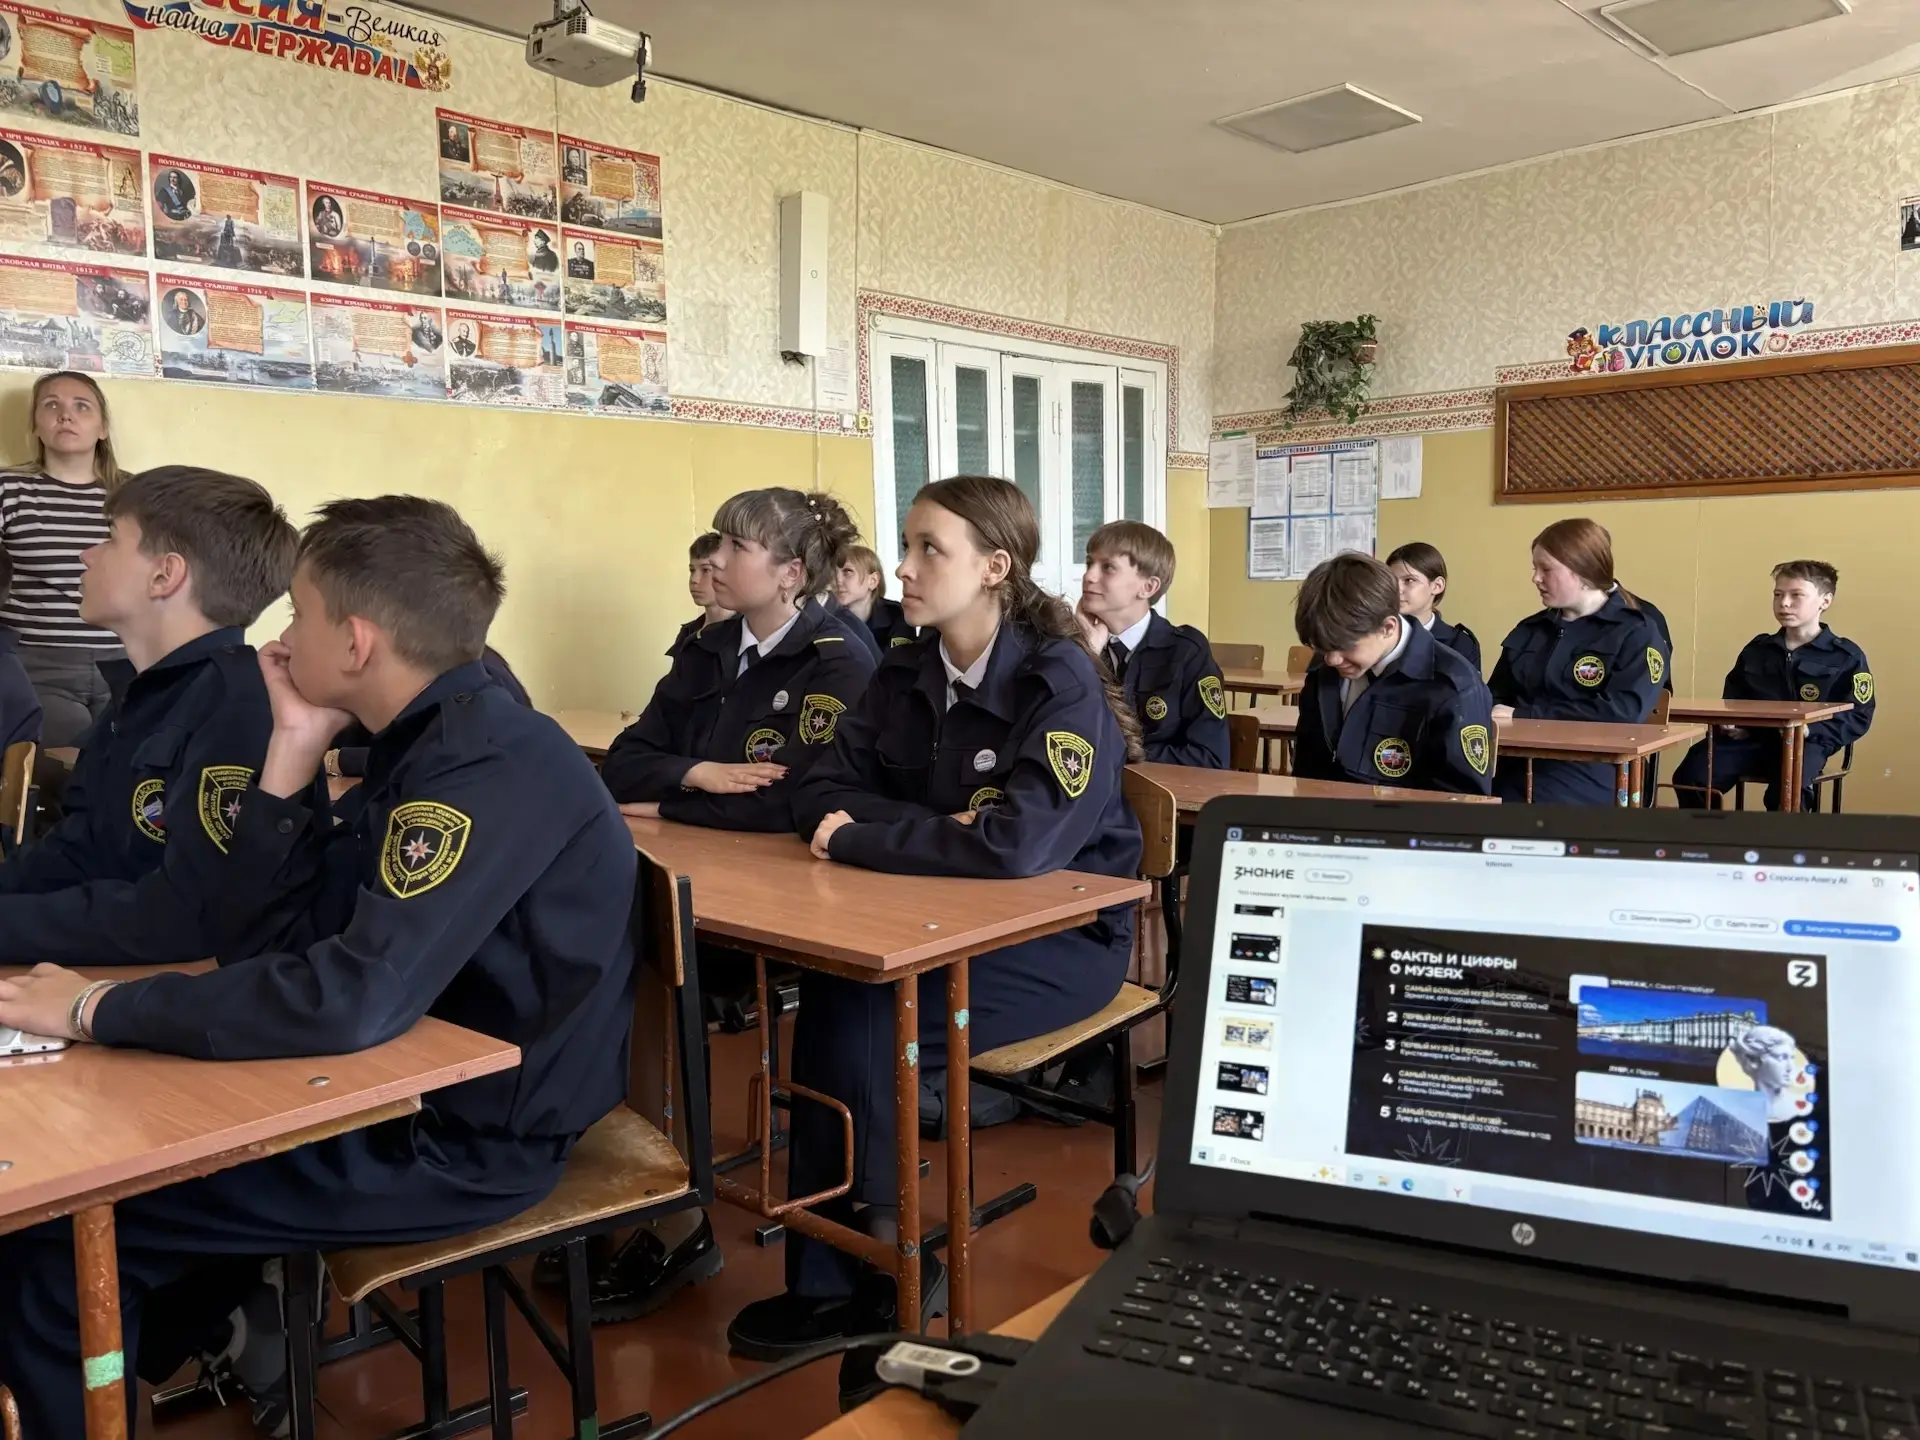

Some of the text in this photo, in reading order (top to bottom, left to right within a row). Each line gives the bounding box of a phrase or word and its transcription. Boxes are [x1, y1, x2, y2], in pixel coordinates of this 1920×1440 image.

[345, 7, 442, 46] Великая
[146, 4, 407, 83] наша ДЕРЖАВА!
[158, 158, 201, 170] ПОЛТАВСКАЯ
[203, 166, 224, 175] БИТВА
[42, 262, 66, 271] БИТВА
[161, 277, 202, 287] ГАНГУТСКОЕ
[204, 282, 239, 292] СРАЖЕНИЕ
[1598, 298, 1813, 348] КЛАССНЫЙ
[1626, 331, 1763, 369] УГОЛОК
[1391, 950, 1518, 970] ФАКТЫ И ЦИФРЫ
[1390, 963, 1464, 980] О МУЗЕЯХ
[1389, 984, 1527, 1001] 1 САМЫЙ БОЛЬШОЙ МУЗЕЙ РОССИИ
[1386, 1011, 1399, 1023] 2
[1402, 1012, 1431, 1021] ПЕРВЫЙ
[1432, 1014, 1456, 1023] МУЗЕЙ
[1463, 1018, 1484, 1026] МИРЕ
[1384, 1039, 1396, 1051] 3
[1400, 1041, 1430, 1050] ПЕРВЫЙ
[1430, 1043, 1454, 1052] МУЗЕЙ
[1461, 1047, 1493, 1057] РОССИИ
[1382, 1072, 1394, 1085] 4
[1399, 1070, 1499, 1087] САМЫЙ МАЛЕНЬКИЙ МУЗЕЙ
[1379, 1105, 1501, 1125] 5 САМЫЙ ПОПУЛЯРНЫЙ МУЗЕЙ
